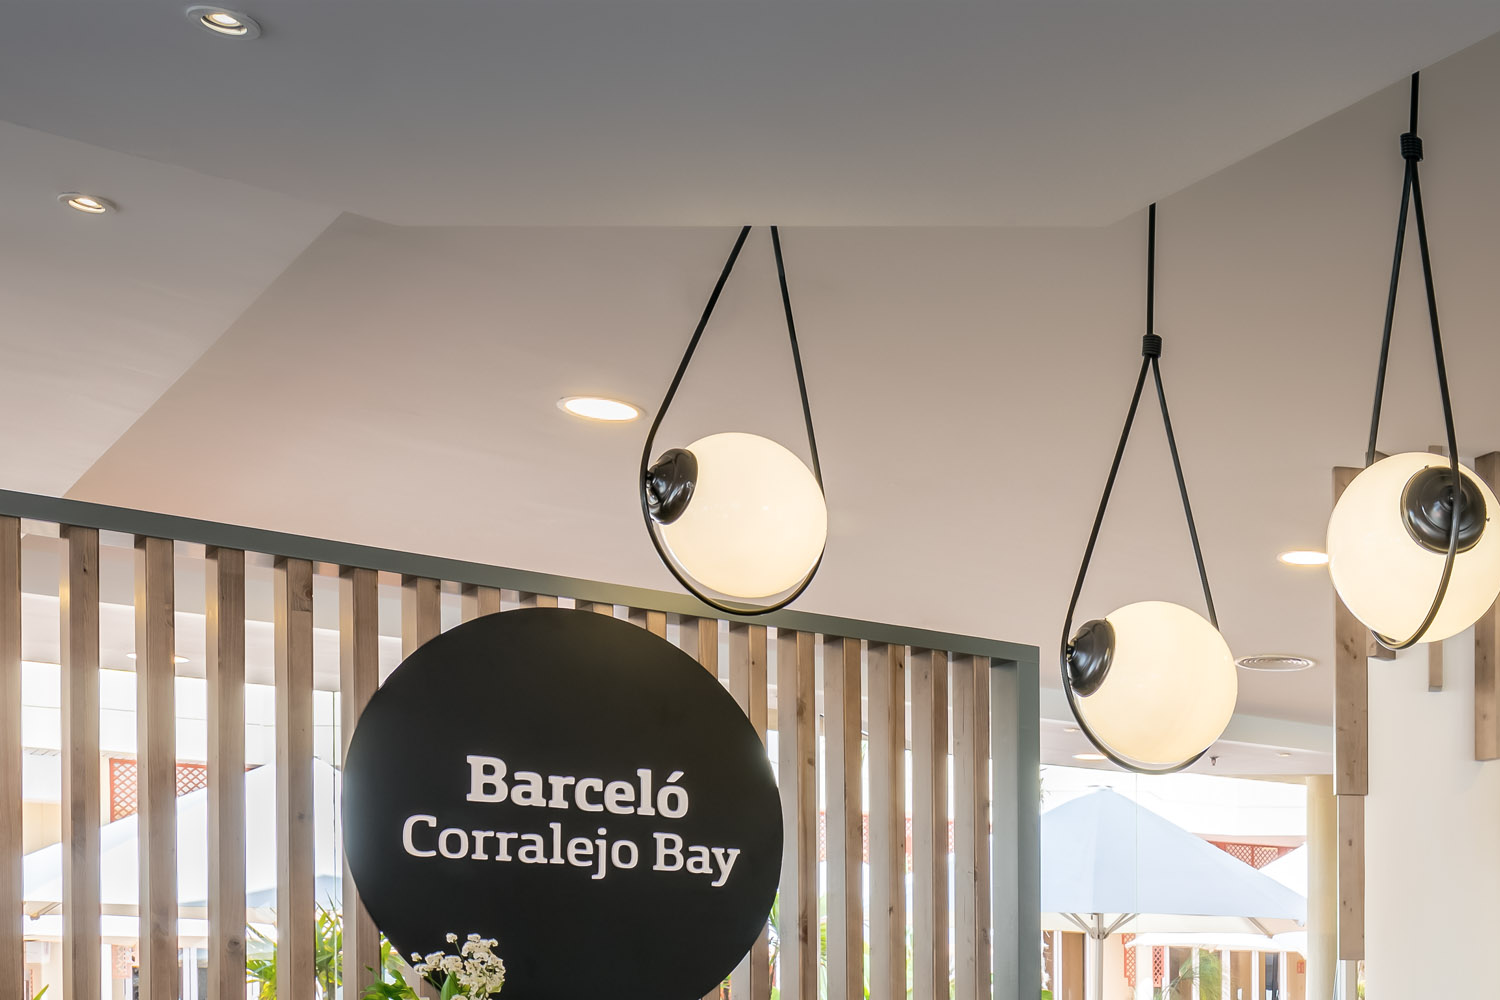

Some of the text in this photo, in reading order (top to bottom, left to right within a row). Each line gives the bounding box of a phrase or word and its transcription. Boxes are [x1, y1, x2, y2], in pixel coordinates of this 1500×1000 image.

[466, 755, 689, 818] Barceló
[402, 814, 740, 887] Corralejo Bay
